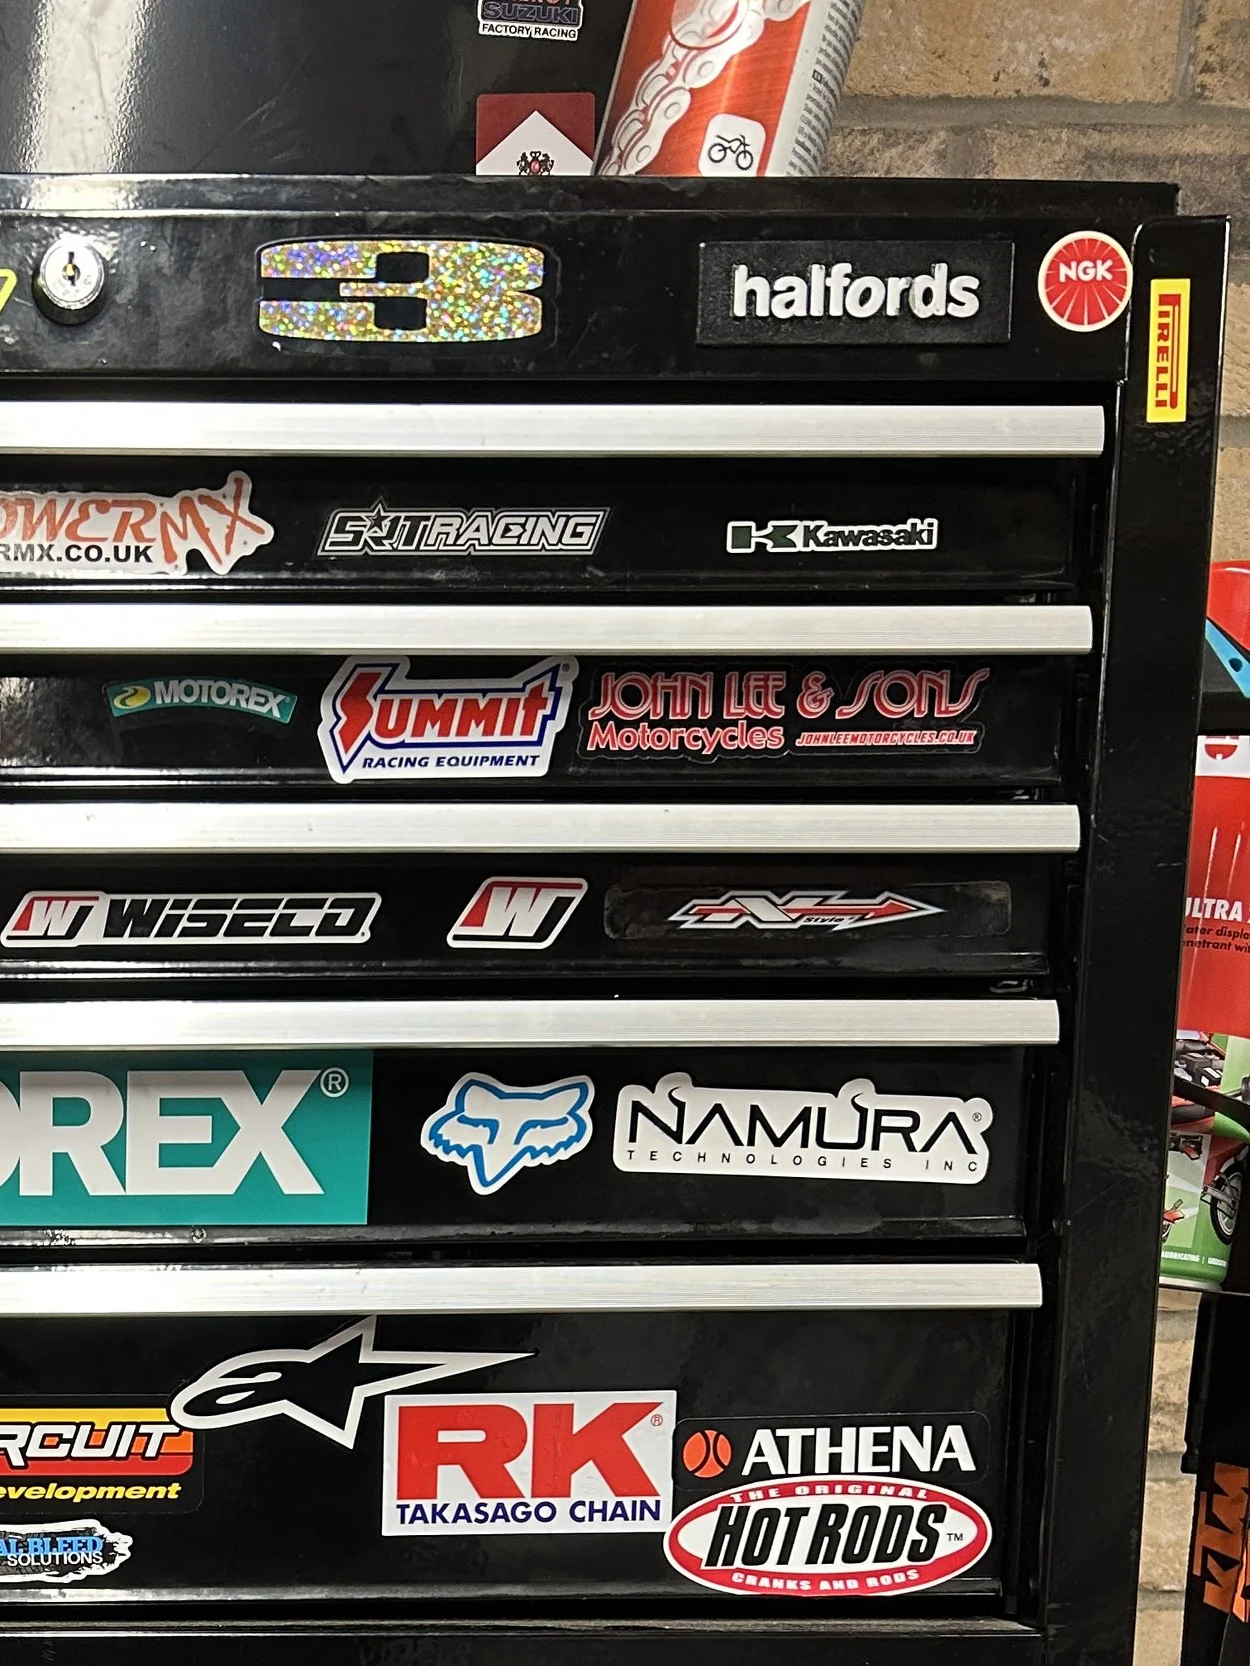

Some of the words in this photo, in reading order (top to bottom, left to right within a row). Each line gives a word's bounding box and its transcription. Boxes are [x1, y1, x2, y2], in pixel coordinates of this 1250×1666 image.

[483, 1, 578, 24] SUZUKI
[482, 24, 531, 35] FACTORY
[534, 27, 576, 38] RACING
[1058, 258, 1114, 283] NGK
[732, 263, 981, 319] halfords
[1155, 293, 1180, 410] PIRELLI
[802, 520, 935, 549] Kawasaki
[154, 679, 285, 718] MOTOREX
[588, 671, 715, 720] JOHN
[722, 671, 787, 719] LEE
[795, 670, 834, 719] &
[834, 667, 991, 719] SONS
[586, 719, 785, 755] Motorcycles
[795, 729, 978, 747] JOHNLEEMOTORCYCLES.CO.UK
[361, 755, 428, 769] RACING
[435, 754, 541, 769] EQUIPMENT
[1184, 925, 1214, 936] ater
[628, 1085, 978, 1155] NAMURA
[627, 1150, 893, 1171] TECHNOLOGIES
[925, 1158, 979, 1173] INC
[396, 1401, 664, 1501] RK
[740, 1424, 978, 1476] ATHENA
[729, 1487, 781, 1502] THE
[793, 1483, 929, 1500] ORIGINAL
[396, 1500, 557, 1525] TAKASAGO
[568, 1499, 662, 1522] CHAIN
[25, 1535, 105, 1556] BLEED
[704, 1505, 811, 1567] HOT
[804, 1502, 949, 1566] RODS
[1192, 1462, 1249, 1613] KTM
[6, 1551, 104, 1567] SOLUTIONS
[730, 1571, 813, 1591] CRANKS
[818, 1579, 860, 1591] AND
[865, 1568, 921, 1588] RODS
